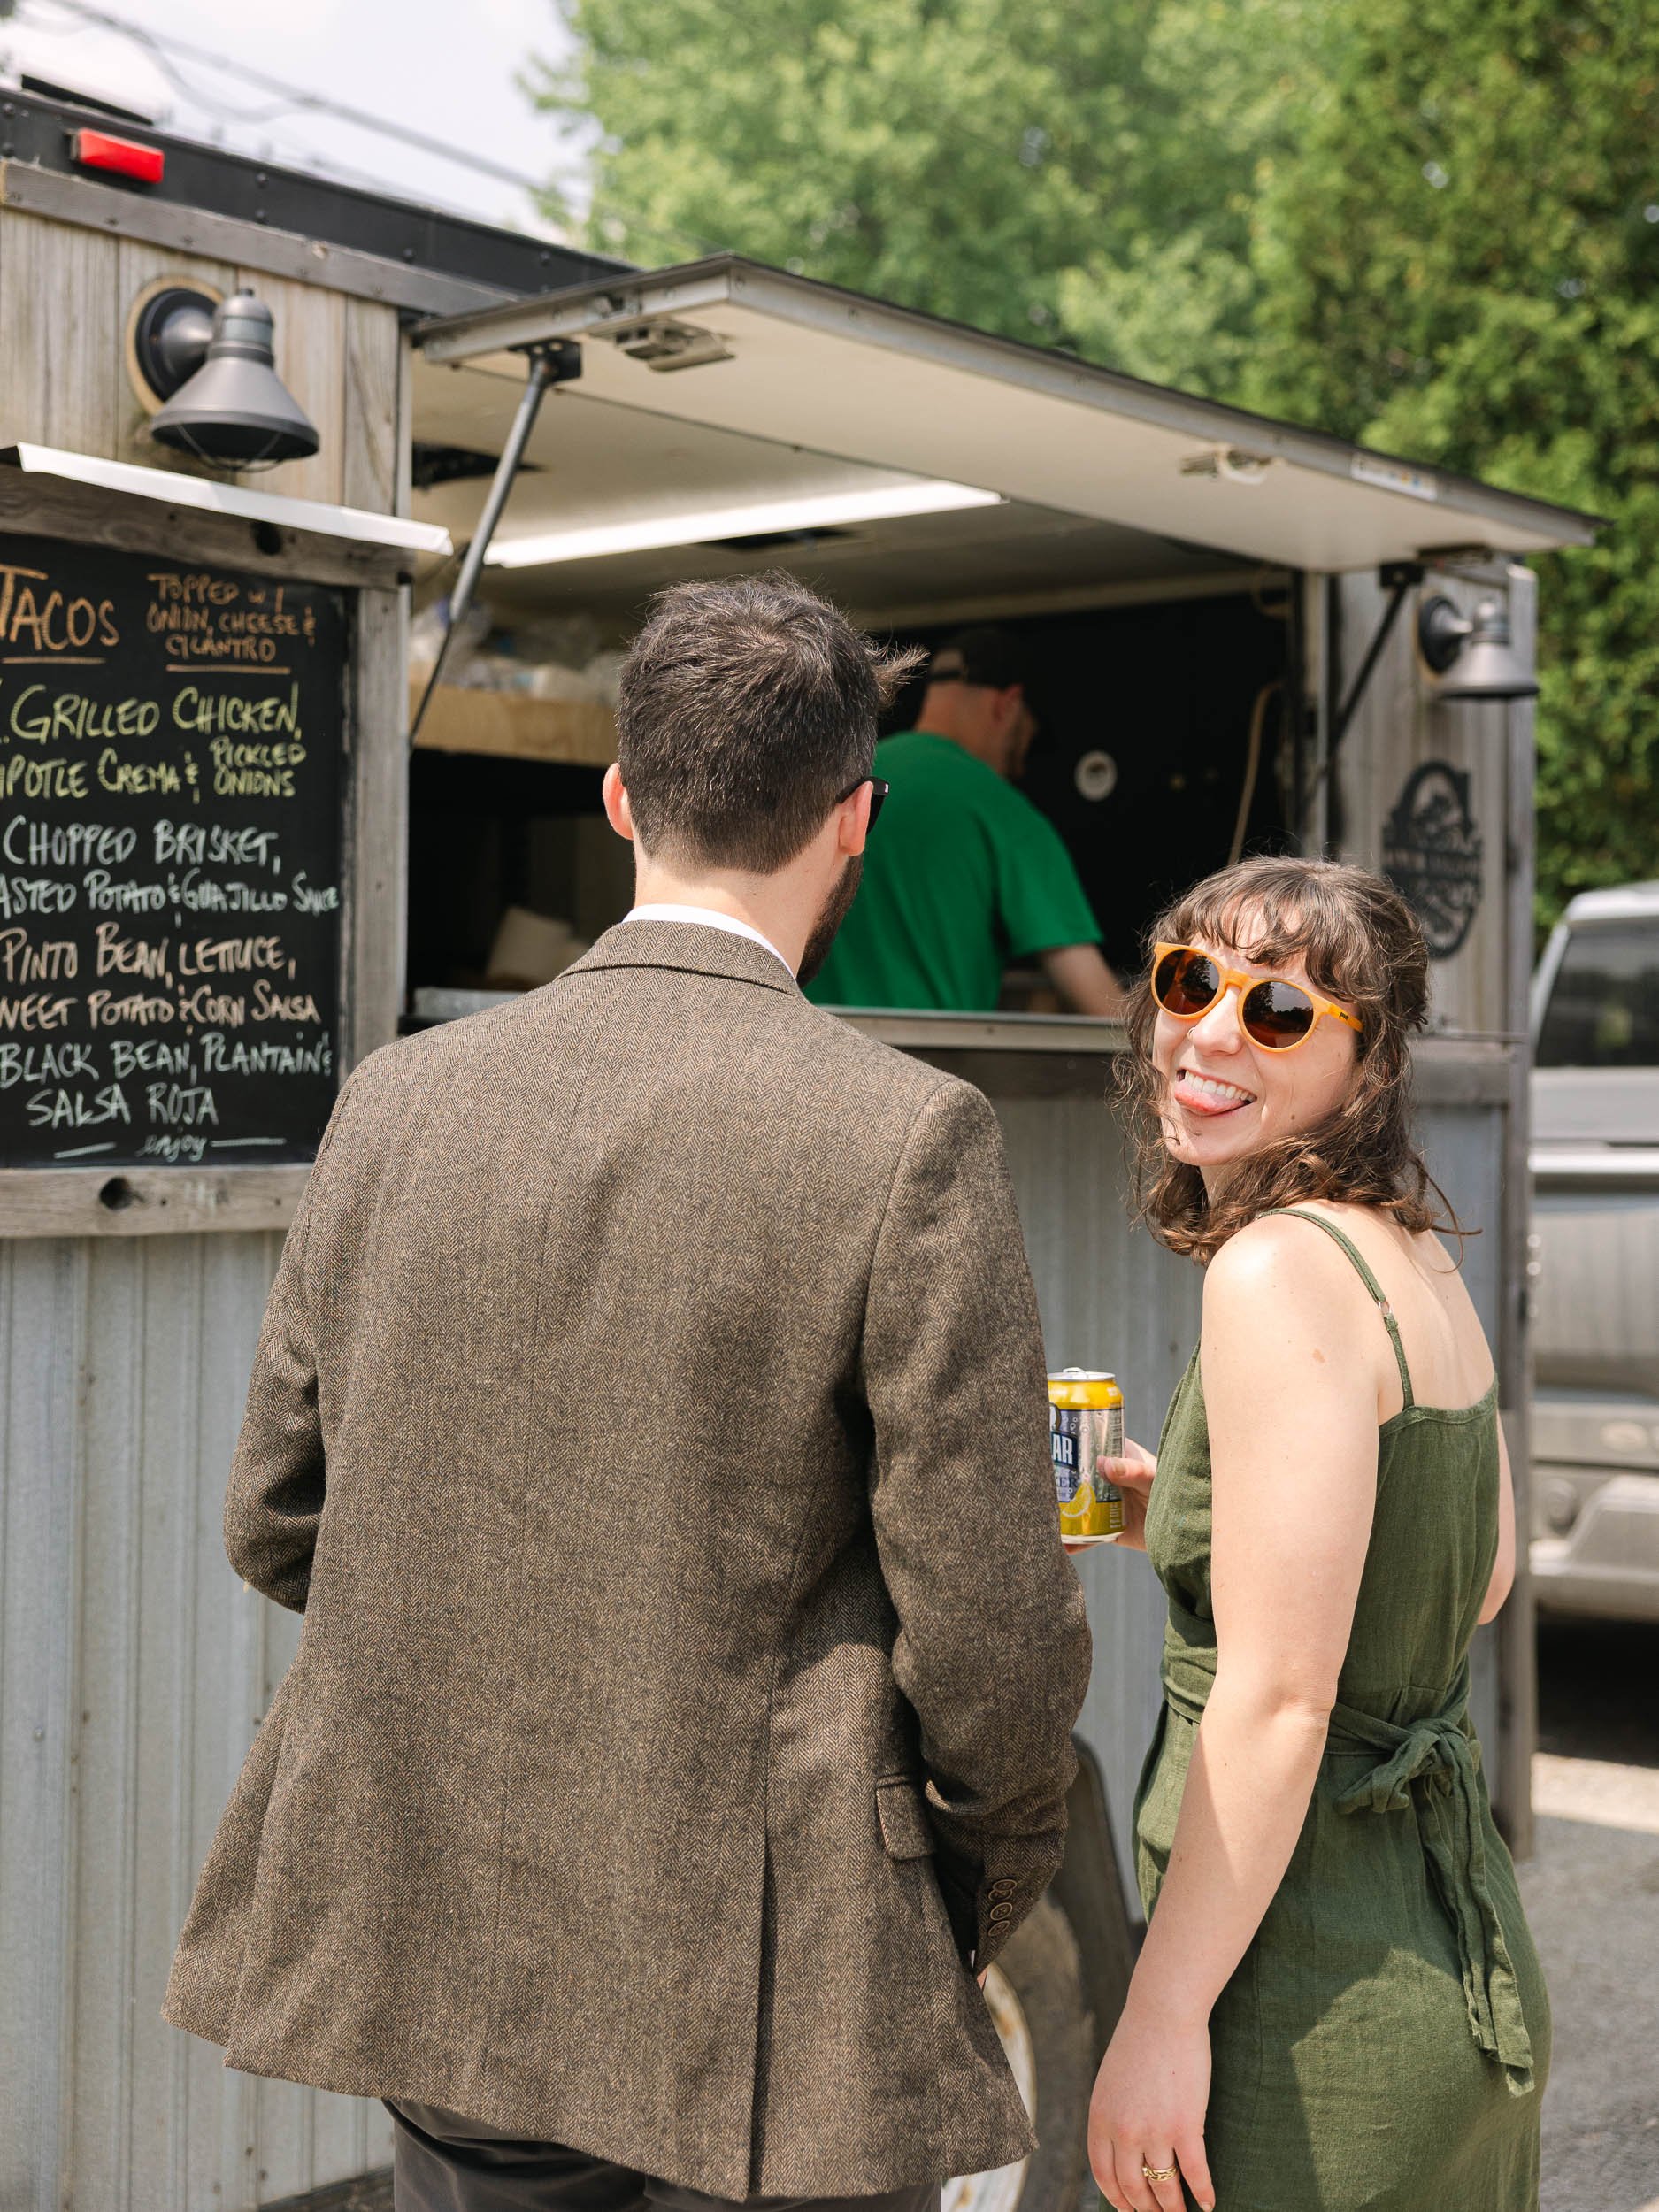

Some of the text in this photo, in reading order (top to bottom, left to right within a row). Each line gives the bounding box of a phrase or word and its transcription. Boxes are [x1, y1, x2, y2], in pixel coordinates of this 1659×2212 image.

[0, 564, 119, 650] TACOS
[147, 573, 239, 605] TOPPED
[219, 611, 299, 636] CHEESE
[165, 634, 276, 662] CILANTRO
[10, 683, 160, 745] GRILLED
[209, 735, 307, 769] PICKLED
[213, 764, 296, 797] ONIONS
[3, 814, 281, 876] CHOPPED BRISKET,
[0, 926, 78, 985] PINTO
[88, 989, 175, 1030] POTATO
[250, 979, 322, 1025] SALSA
[0, 1042, 100, 1089] BLACK
[25, 1082, 220, 1130] SALSA ROJA
